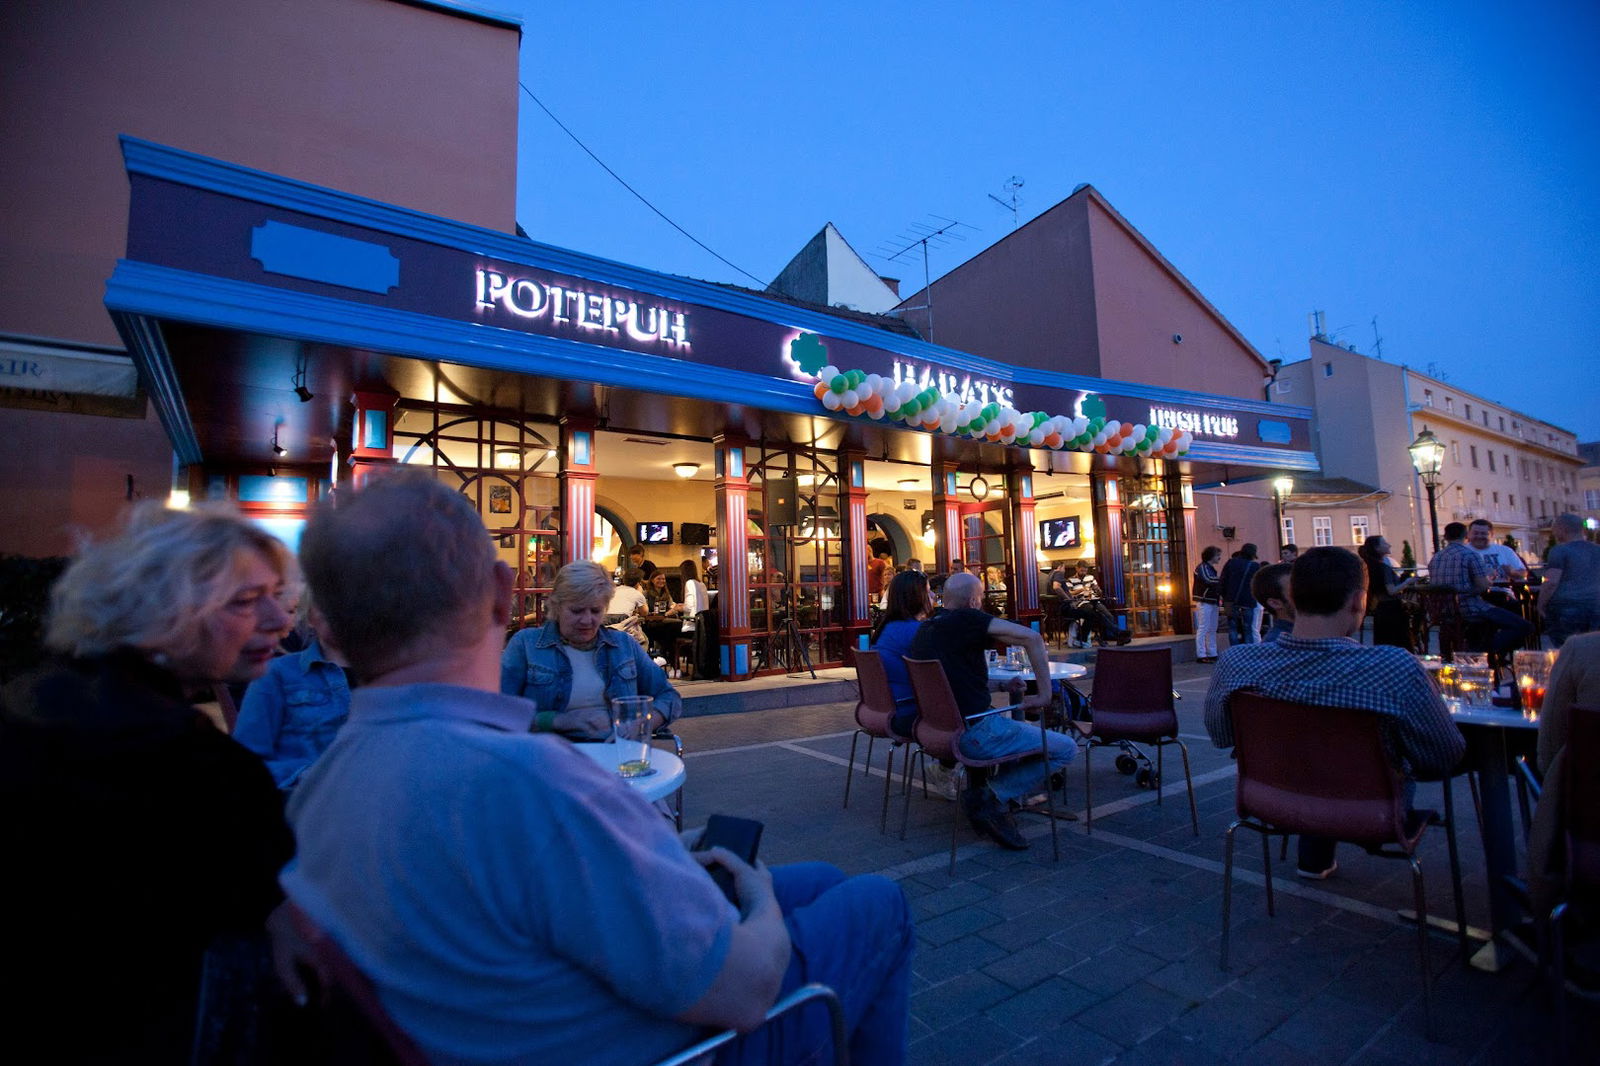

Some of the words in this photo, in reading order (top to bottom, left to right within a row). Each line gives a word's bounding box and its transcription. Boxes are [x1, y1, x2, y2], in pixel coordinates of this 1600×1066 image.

[475, 268, 692, 346] POTEPUH
[1149, 407, 1203, 434] IRISH
[1203, 413, 1240, 437] PUB
